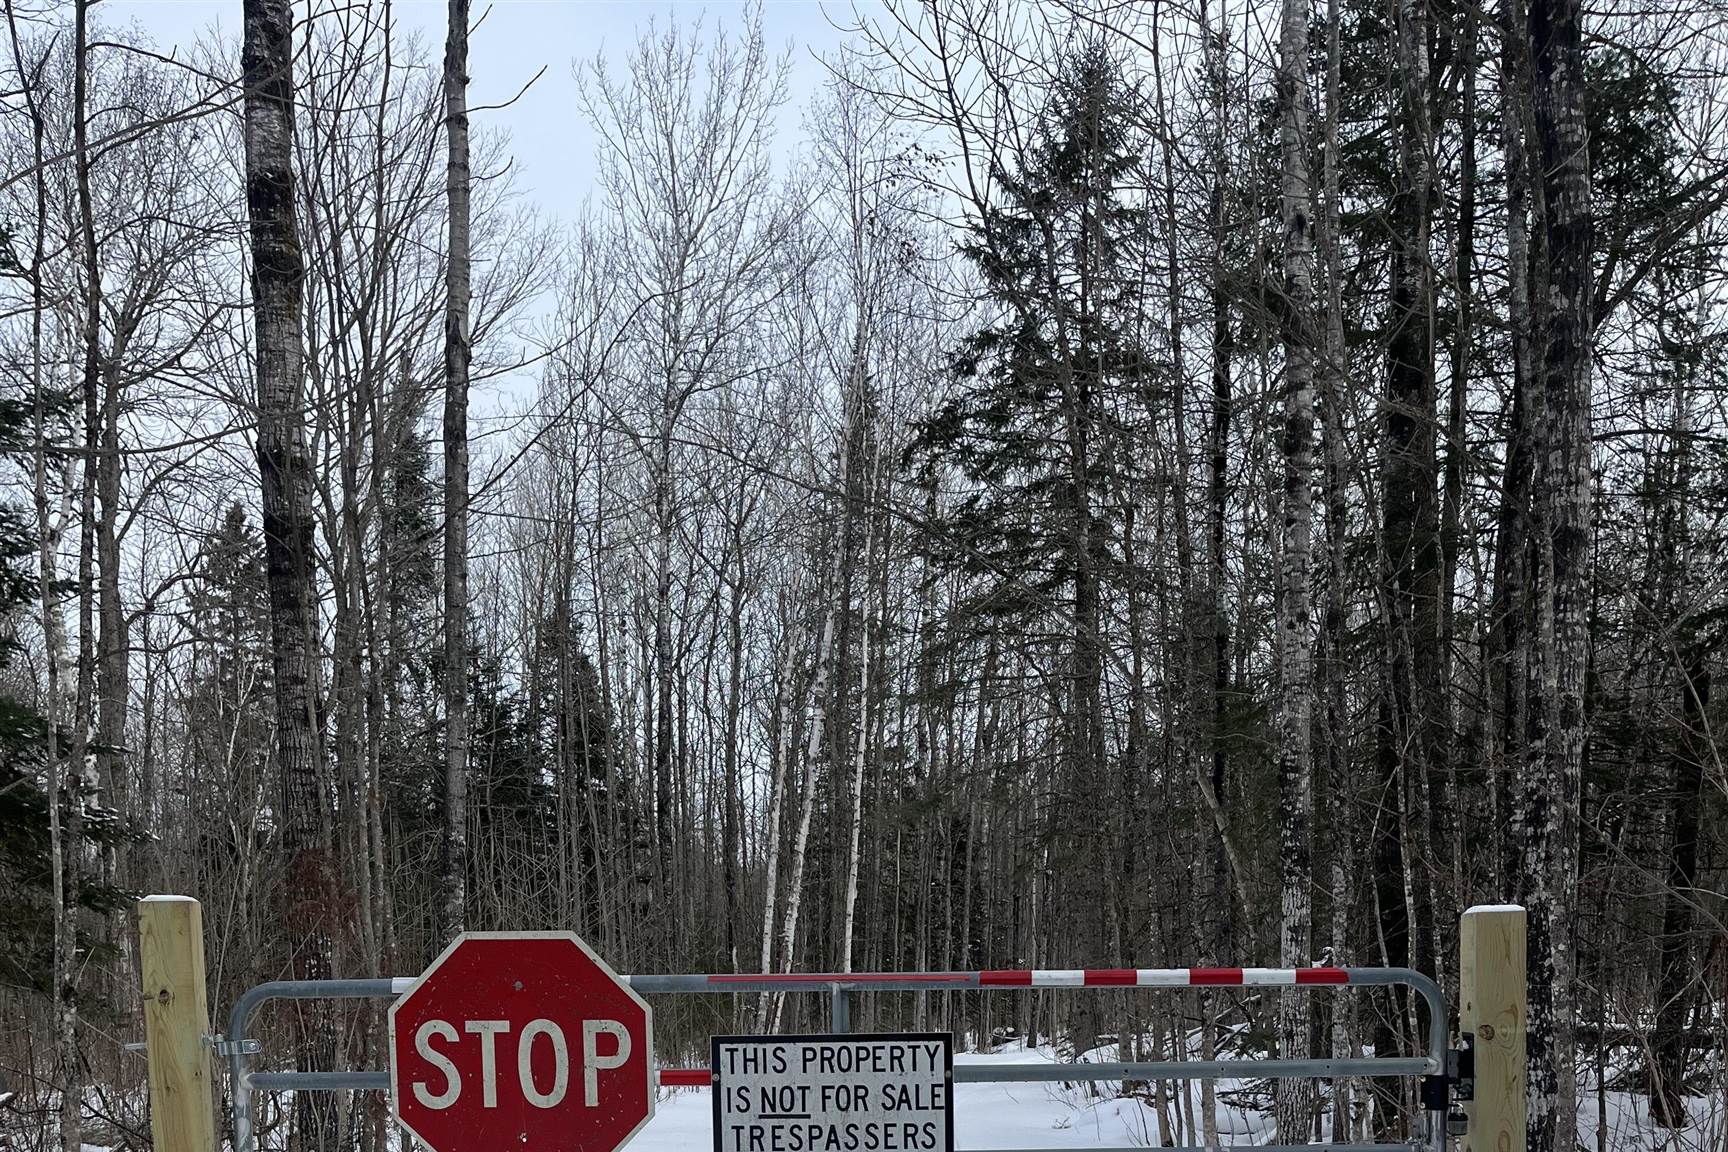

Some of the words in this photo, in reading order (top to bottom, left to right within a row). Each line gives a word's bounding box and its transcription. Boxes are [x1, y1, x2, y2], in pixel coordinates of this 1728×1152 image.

[412, 1018, 632, 1110] STOP
[725, 1046, 787, 1075] THIS
[802, 1044, 941, 1074] PROPERTY
[726, 1086, 751, 1113] IS
[760, 1085, 811, 1113] NOT
[821, 1084, 869, 1112] FOR
[881, 1083, 945, 1111] SALE
[731, 1122, 937, 1152] TRESPASSERS
